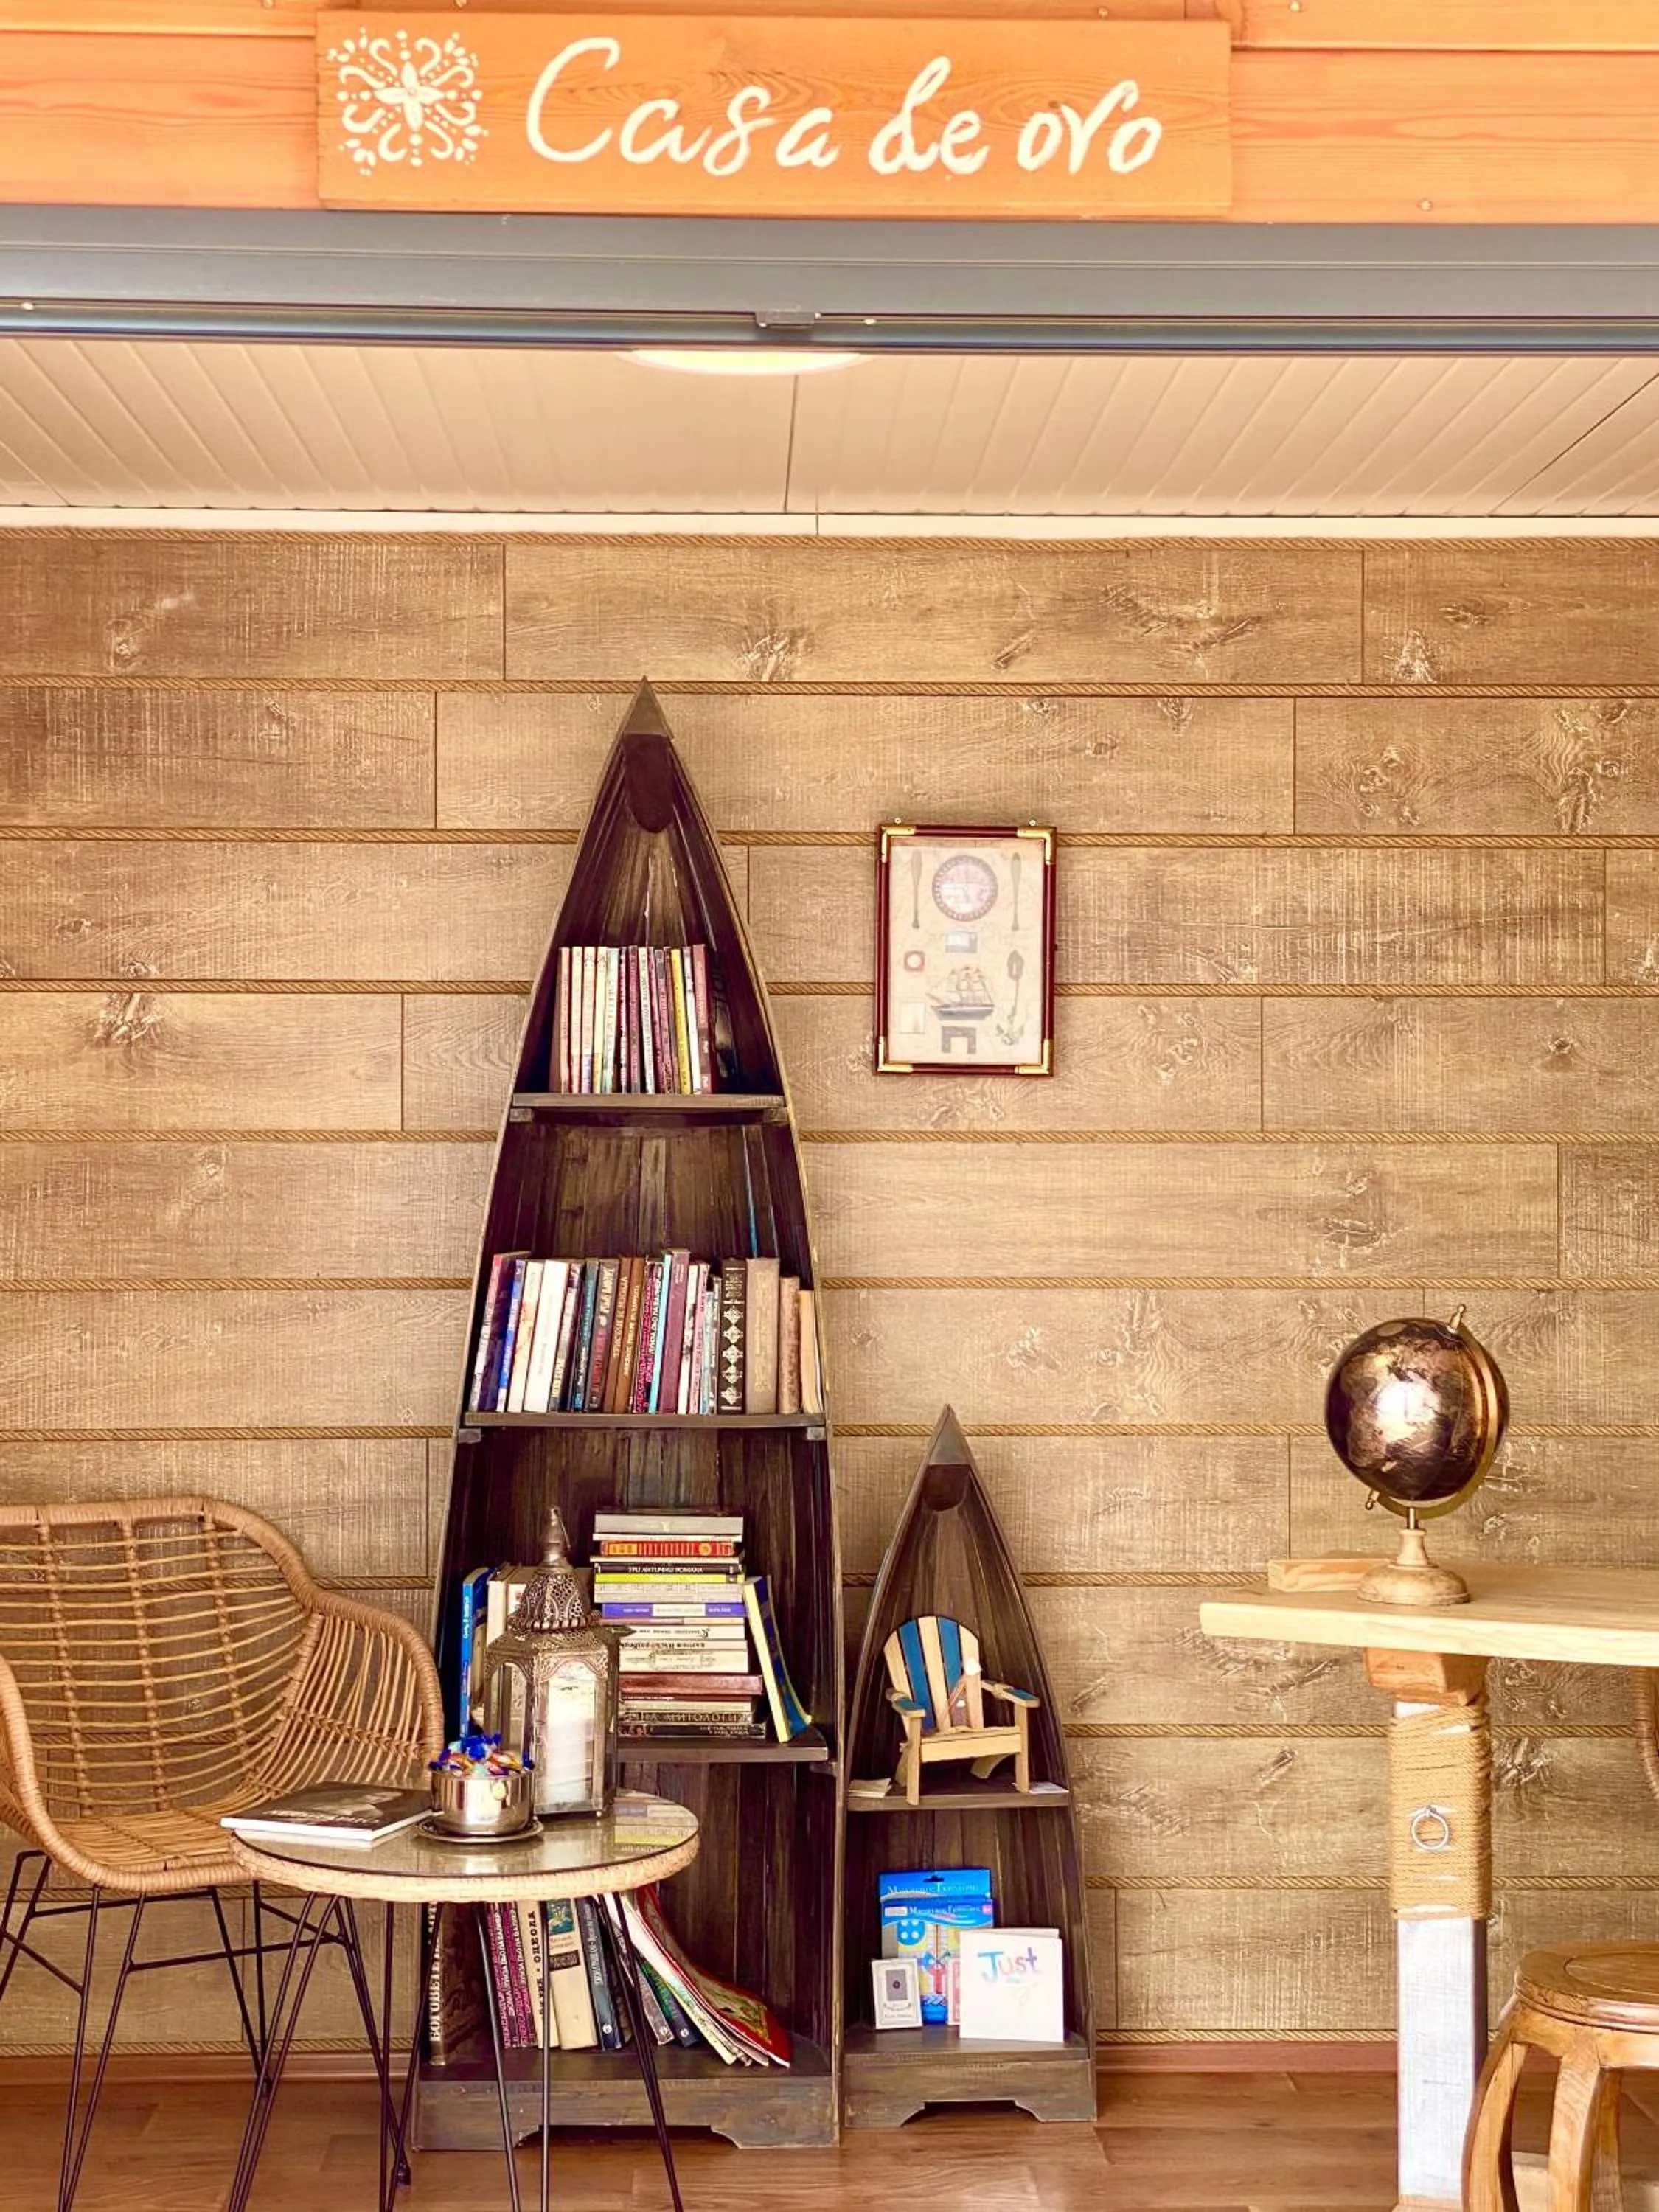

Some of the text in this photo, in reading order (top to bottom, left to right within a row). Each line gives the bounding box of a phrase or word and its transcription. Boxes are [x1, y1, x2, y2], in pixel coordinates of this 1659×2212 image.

[526, 35, 1164, 177] Casa de oro
[977, 1946, 1041, 1983] Just
